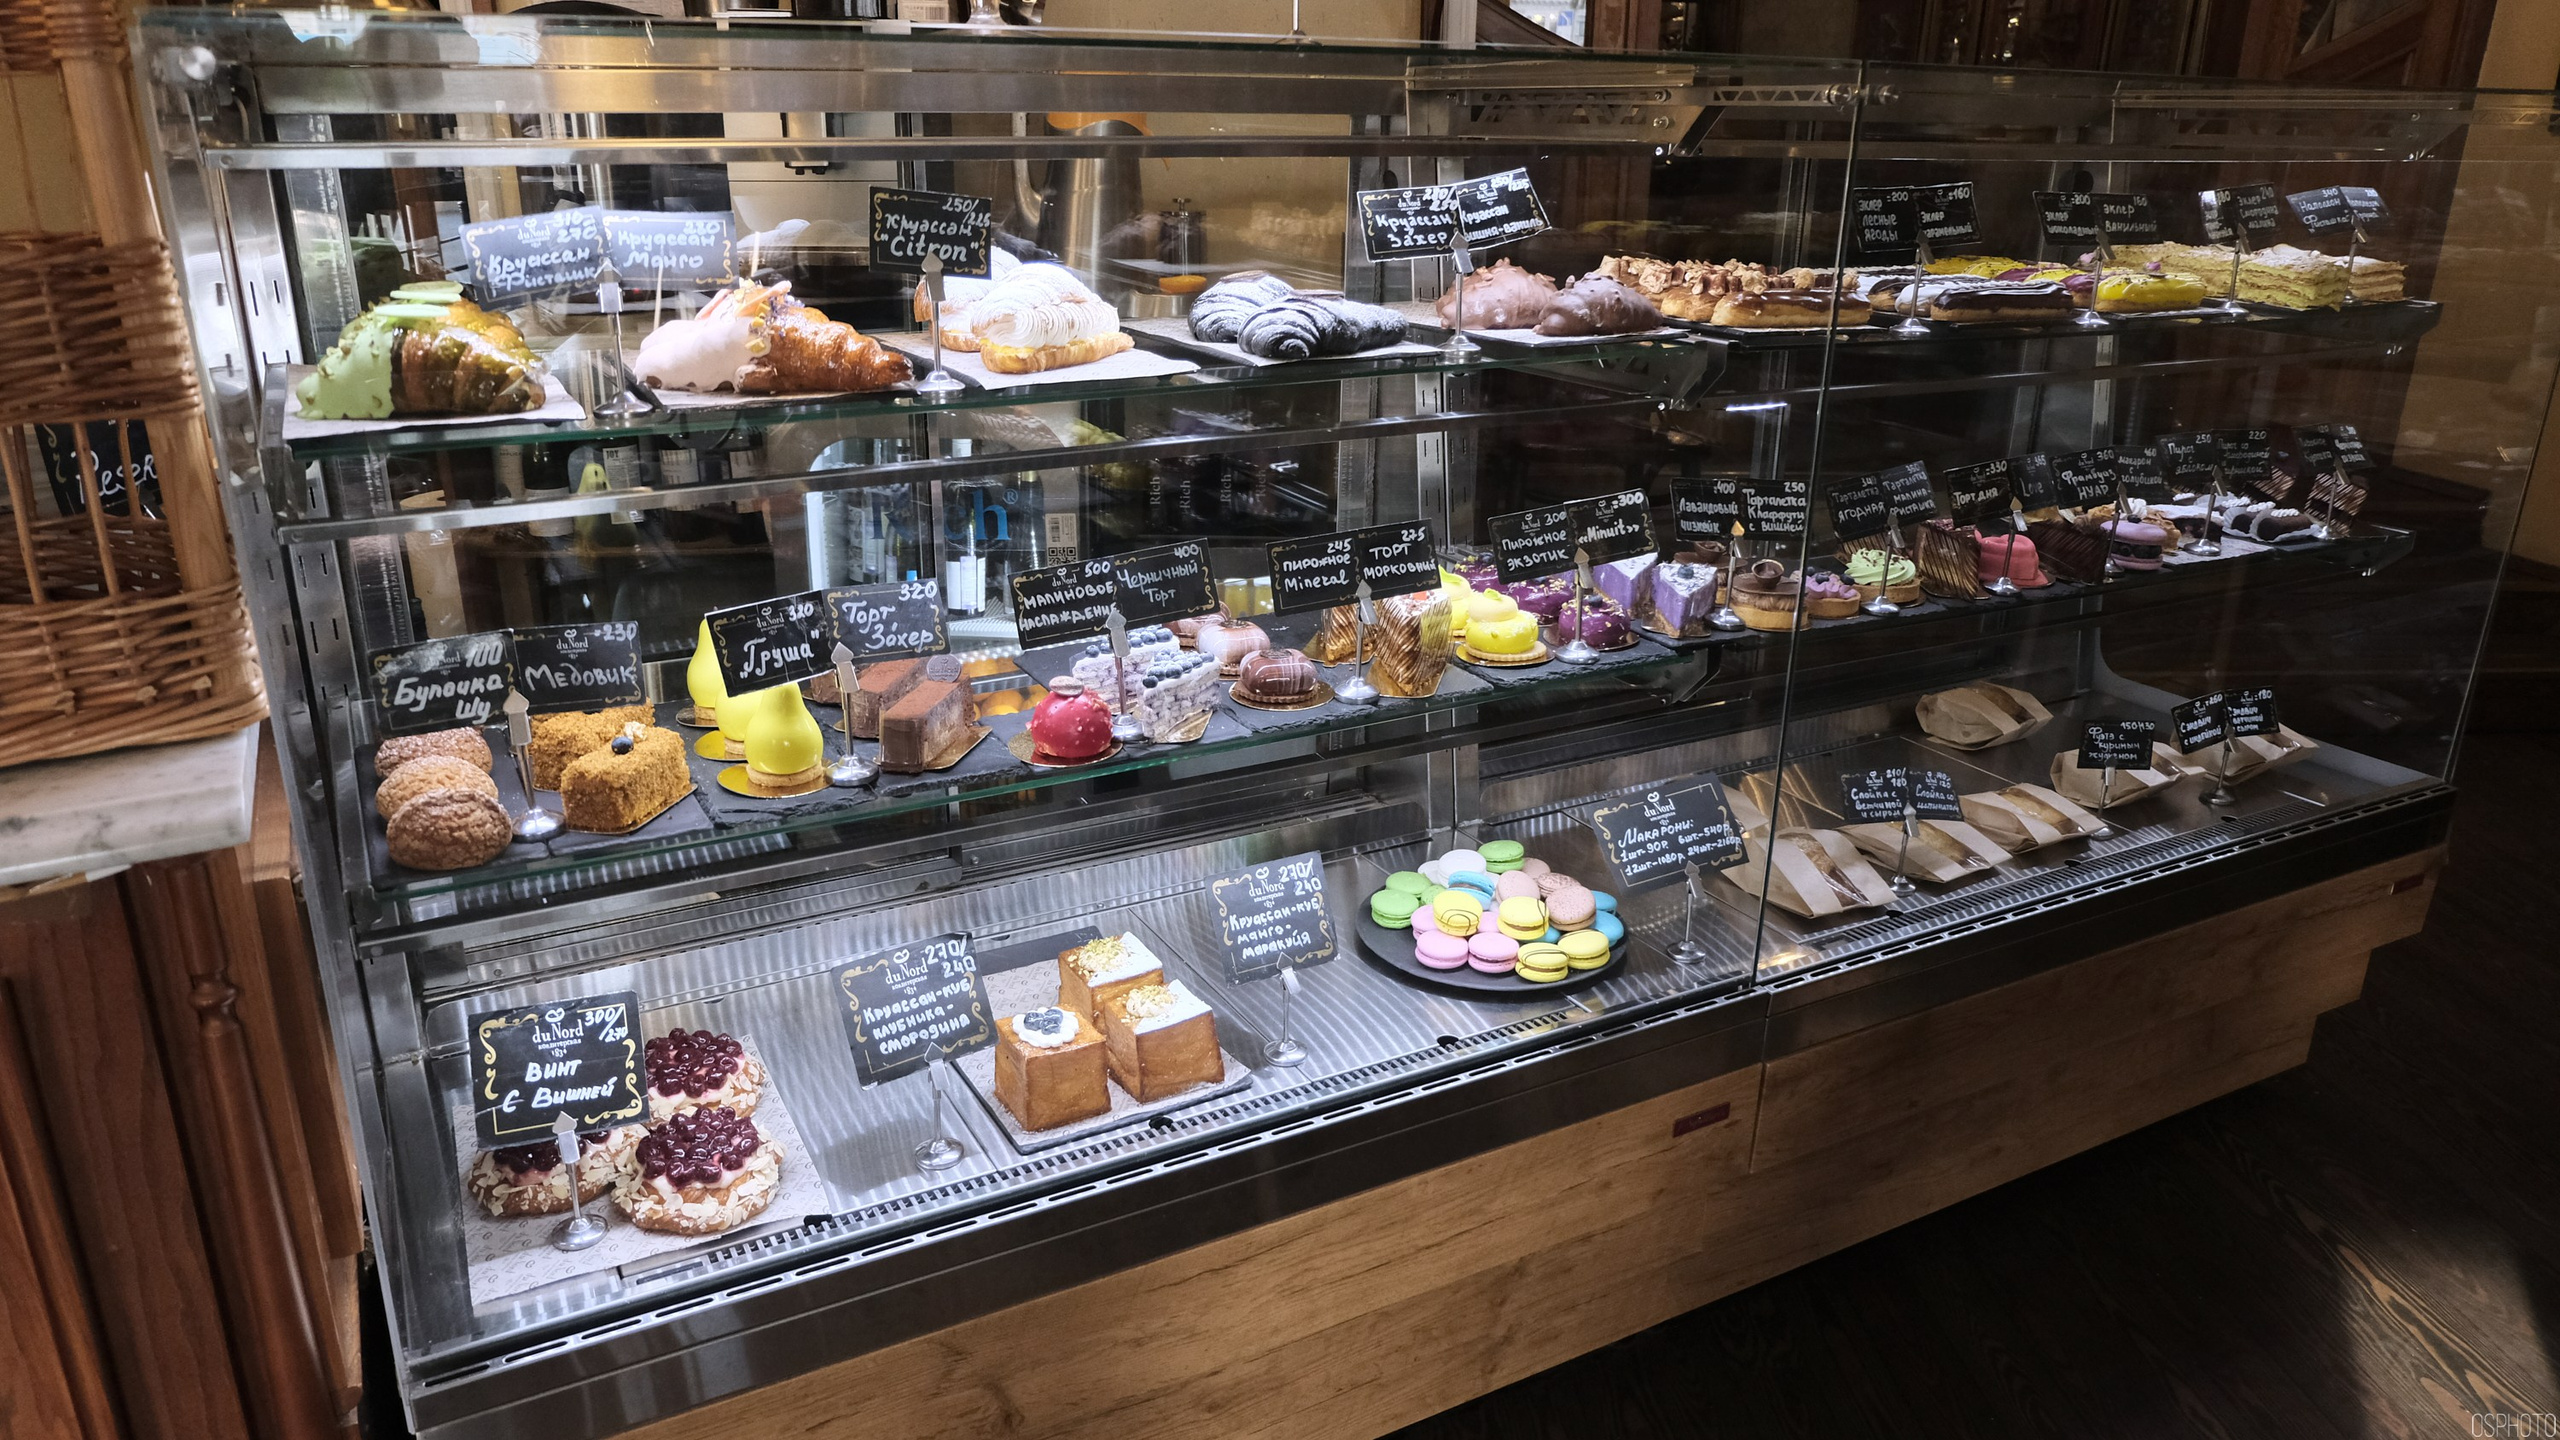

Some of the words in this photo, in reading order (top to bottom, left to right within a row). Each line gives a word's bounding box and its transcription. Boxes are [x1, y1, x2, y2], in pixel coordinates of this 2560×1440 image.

[617, 229, 716, 250] Круассан
[1922, 221, 1973, 239] арамельный
[622, 250, 704, 269] Манго
[2195, 434, 2212, 444] 250
[2248, 430, 2267, 440] 220
[1783, 482, 1806, 493] 250
[1174, 544, 1199, 560] 400
[1327, 538, 1352, 554] 245
[1084, 561, 1111, 579] 500
[1116, 560, 1199, 594] Черничный
[1284, 569, 1350, 593] Mineral
[898, 581, 938, 602] 320
[788, 603, 814, 622] 320
[842, 600, 896, 634] Торт
[393, 673, 504, 713] Булочка
[1295, 877, 1323, 896] 240
[943, 955, 977, 979] 240
